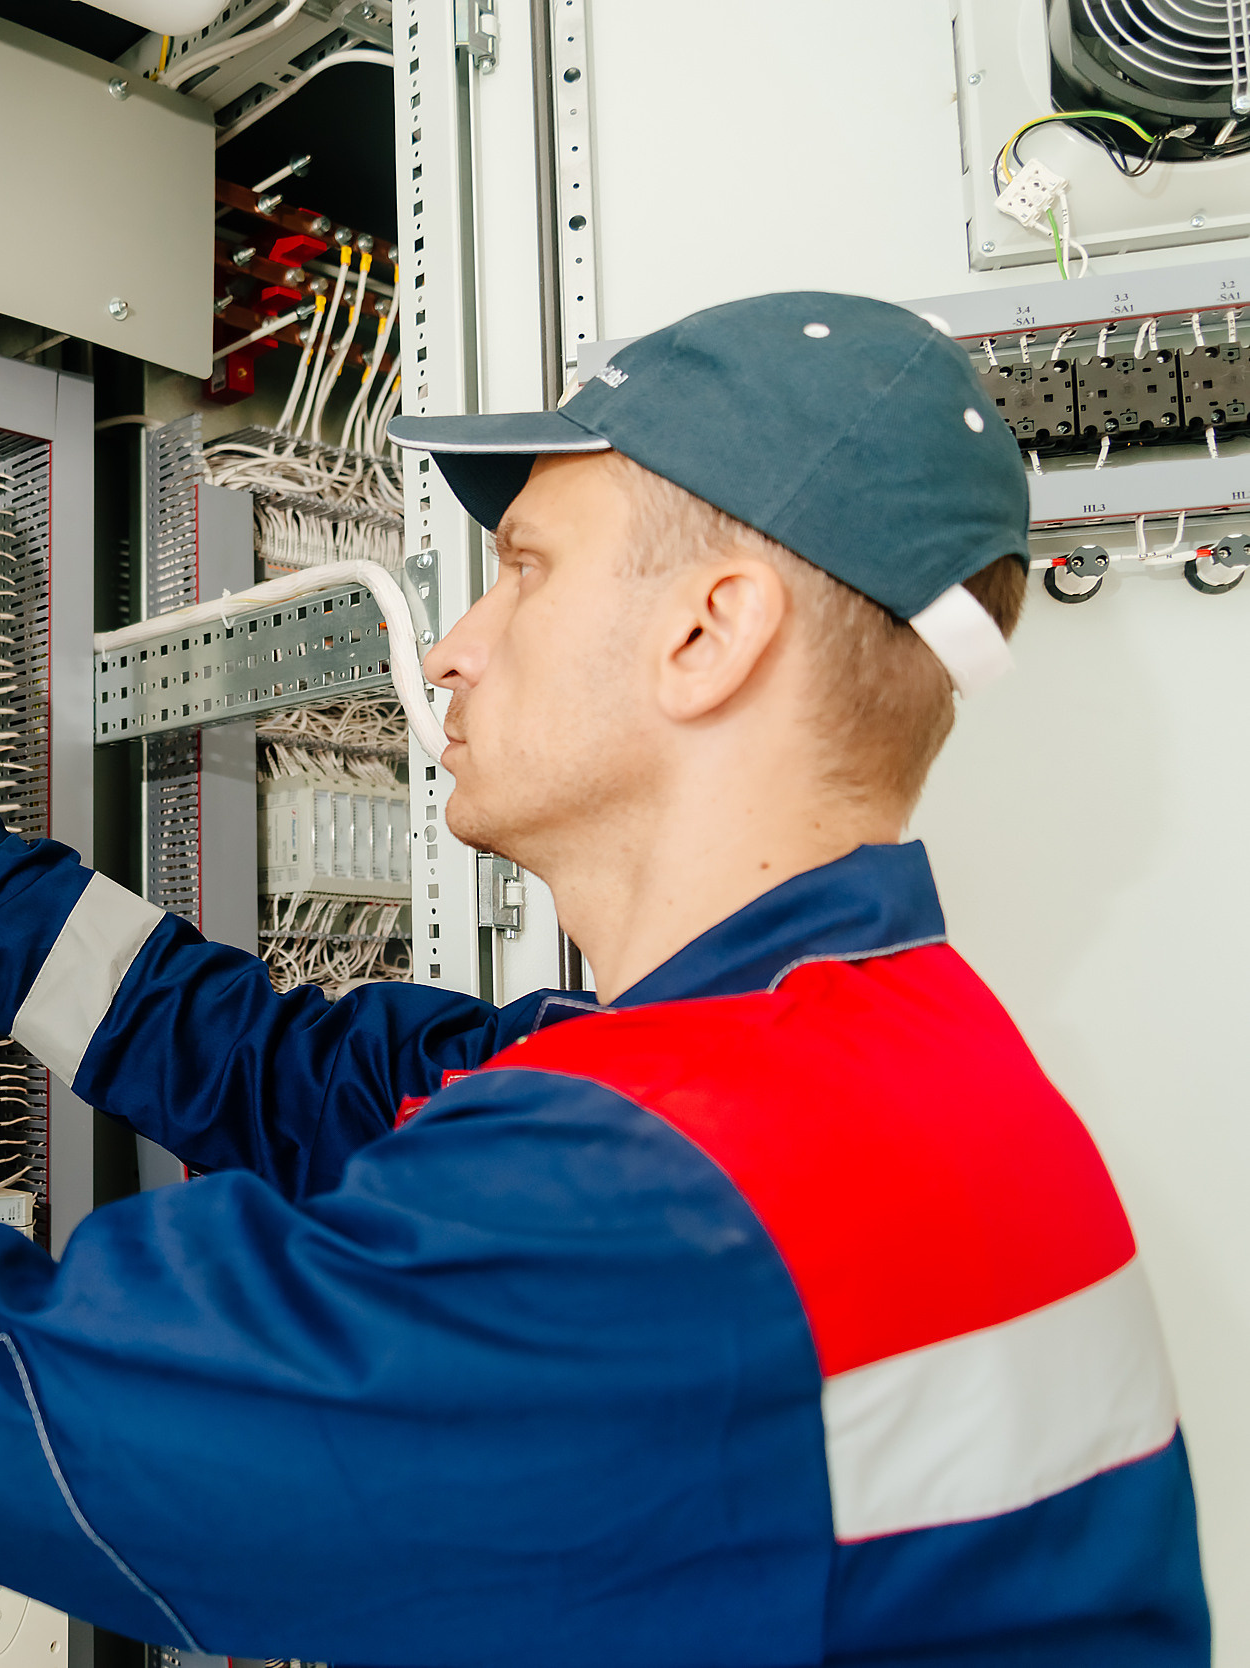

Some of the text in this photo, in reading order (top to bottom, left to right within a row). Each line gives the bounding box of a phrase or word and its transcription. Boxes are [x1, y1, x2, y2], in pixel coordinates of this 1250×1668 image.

[1220, 281, 1235, 289] 3.2
[1114, 293, 1129, 302] 3.3
[1016, 306, 1030, 314] 3.4
[1232, 491, 1250, 500] HL
[1083, 504, 1106, 513] HL3
